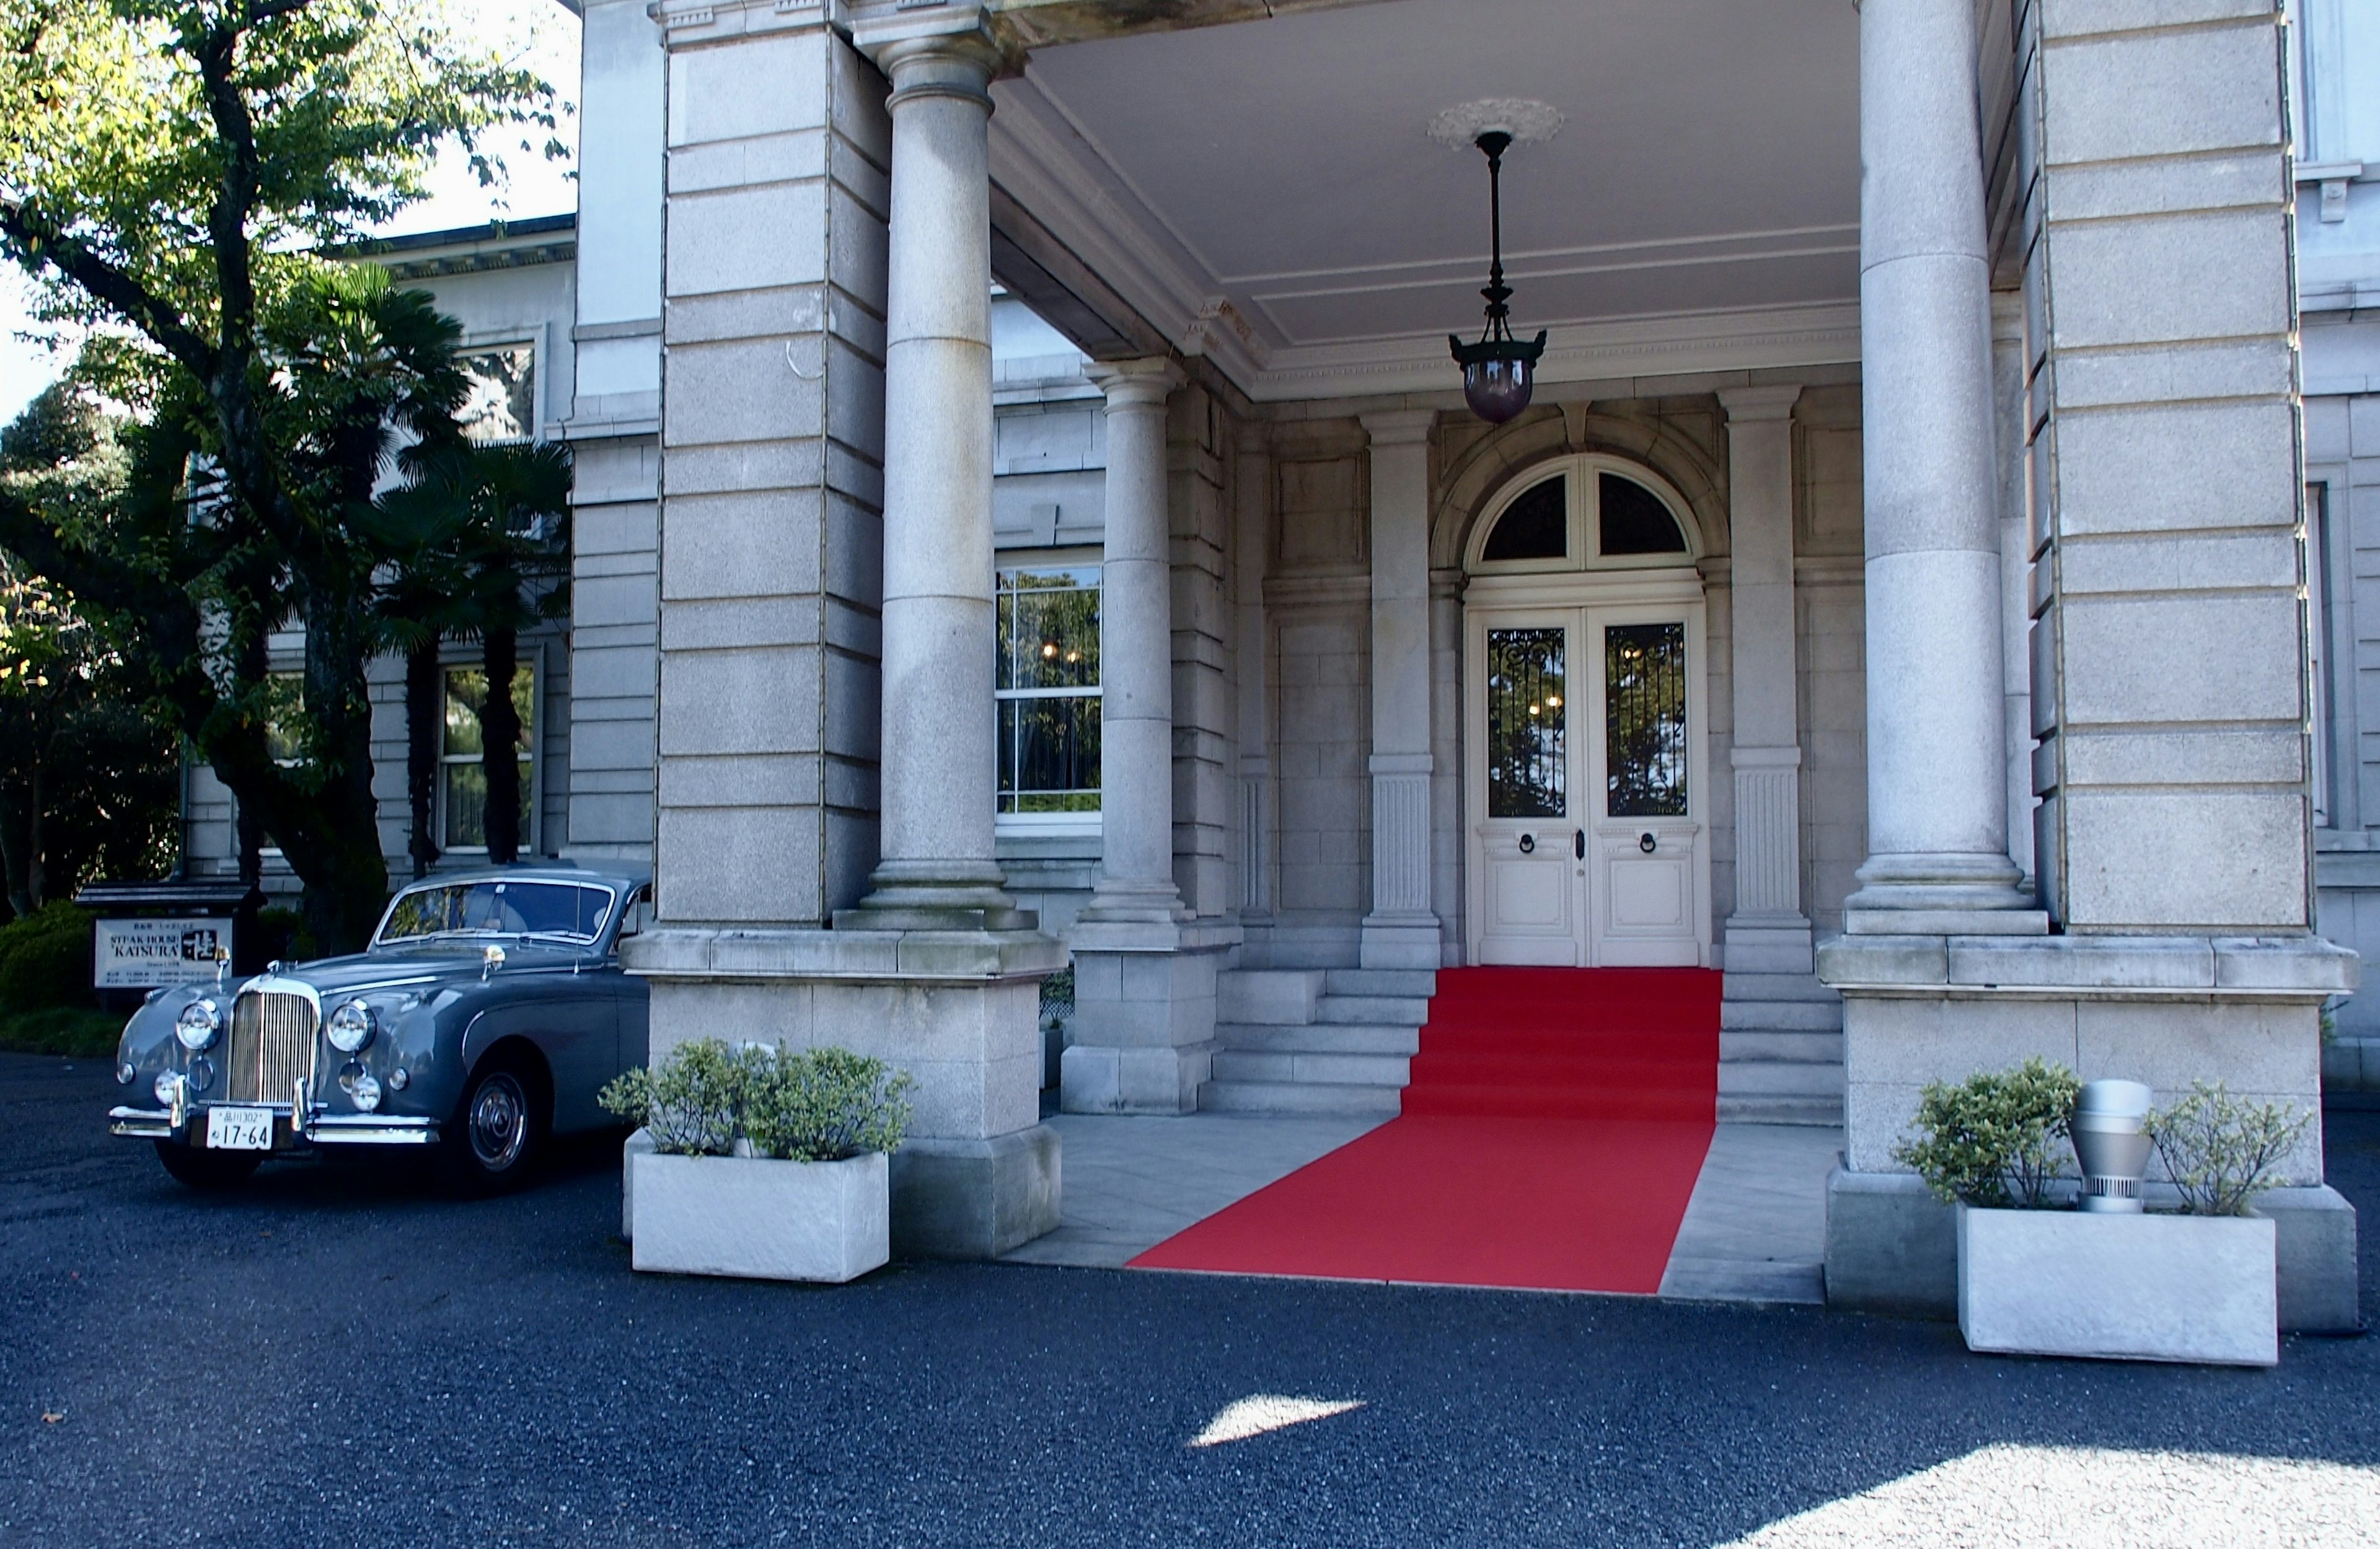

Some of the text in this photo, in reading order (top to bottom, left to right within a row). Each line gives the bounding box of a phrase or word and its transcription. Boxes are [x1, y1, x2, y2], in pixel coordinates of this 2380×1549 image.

[112, 935, 179, 944] STEAK HOUSE
[224, 1125, 267, 1146] 17-64
